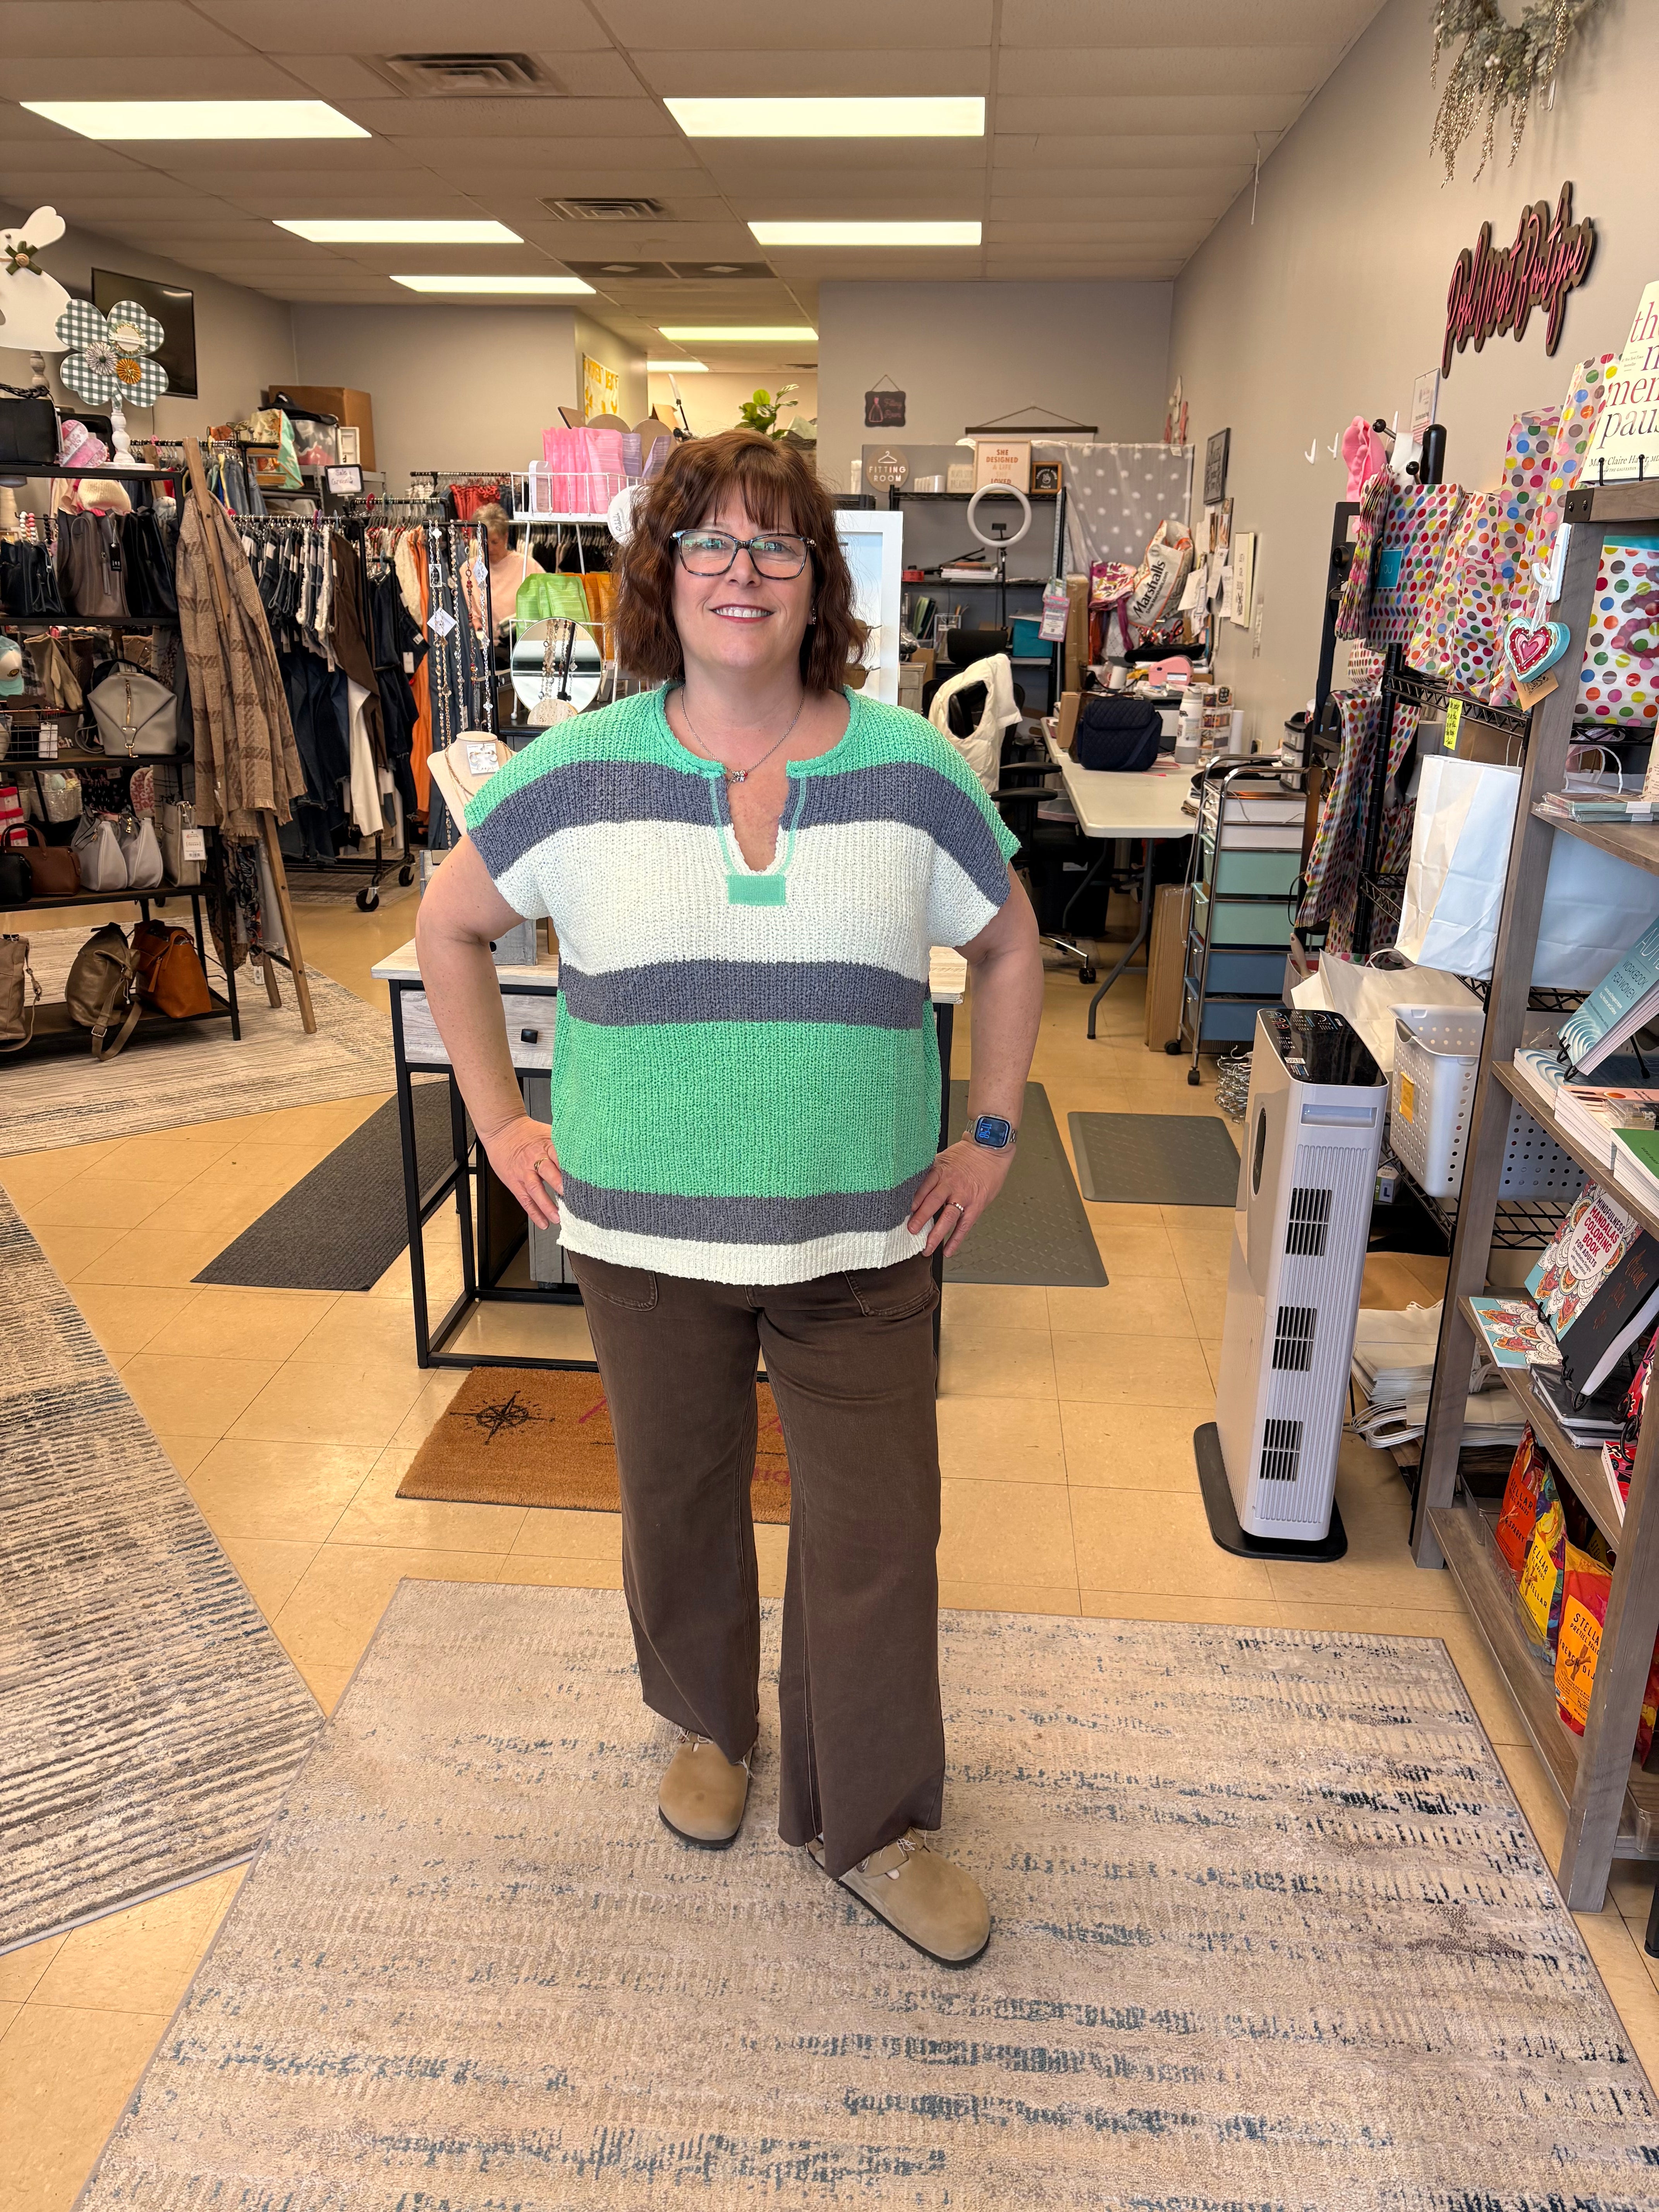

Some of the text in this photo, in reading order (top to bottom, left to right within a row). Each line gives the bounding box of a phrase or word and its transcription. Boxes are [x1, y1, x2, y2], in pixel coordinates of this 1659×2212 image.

[1630, 301, 1659, 343] th
[1596, 409, 1659, 450] pau
[1589, 458, 1606, 467] May
[1607, 457, 1625, 465] Claire
[1133, 560, 1166, 618] Marshalls
[1611, 972, 1637, 1000] FOR WOMEN
[1622, 960, 1648, 988] WORKBOOK
[1384, 1187, 1390, 1197] L
[1590, 1206, 1619, 1244] MANDALAS
[1596, 1197, 1625, 1234] MINDFULNESS
[1582, 1233, 1601, 1257] BOOK
[1584, 1217, 1612, 1254] COLORING
[1575, 1238, 1597, 1267] FOR ADULTS
[1511, 1478, 1533, 1511] STELLAR
[1508, 1520, 1525, 1543] SPARKY
[1533, 1545, 1548, 1575] ELLAR
[1570, 1623, 1600, 1656] PRETZEL BRAID
[1573, 1613, 1600, 1647] STELLA
[1559, 1638, 1580, 1667] FRENCH
[1582, 1665, 1595, 1680] DIJ
